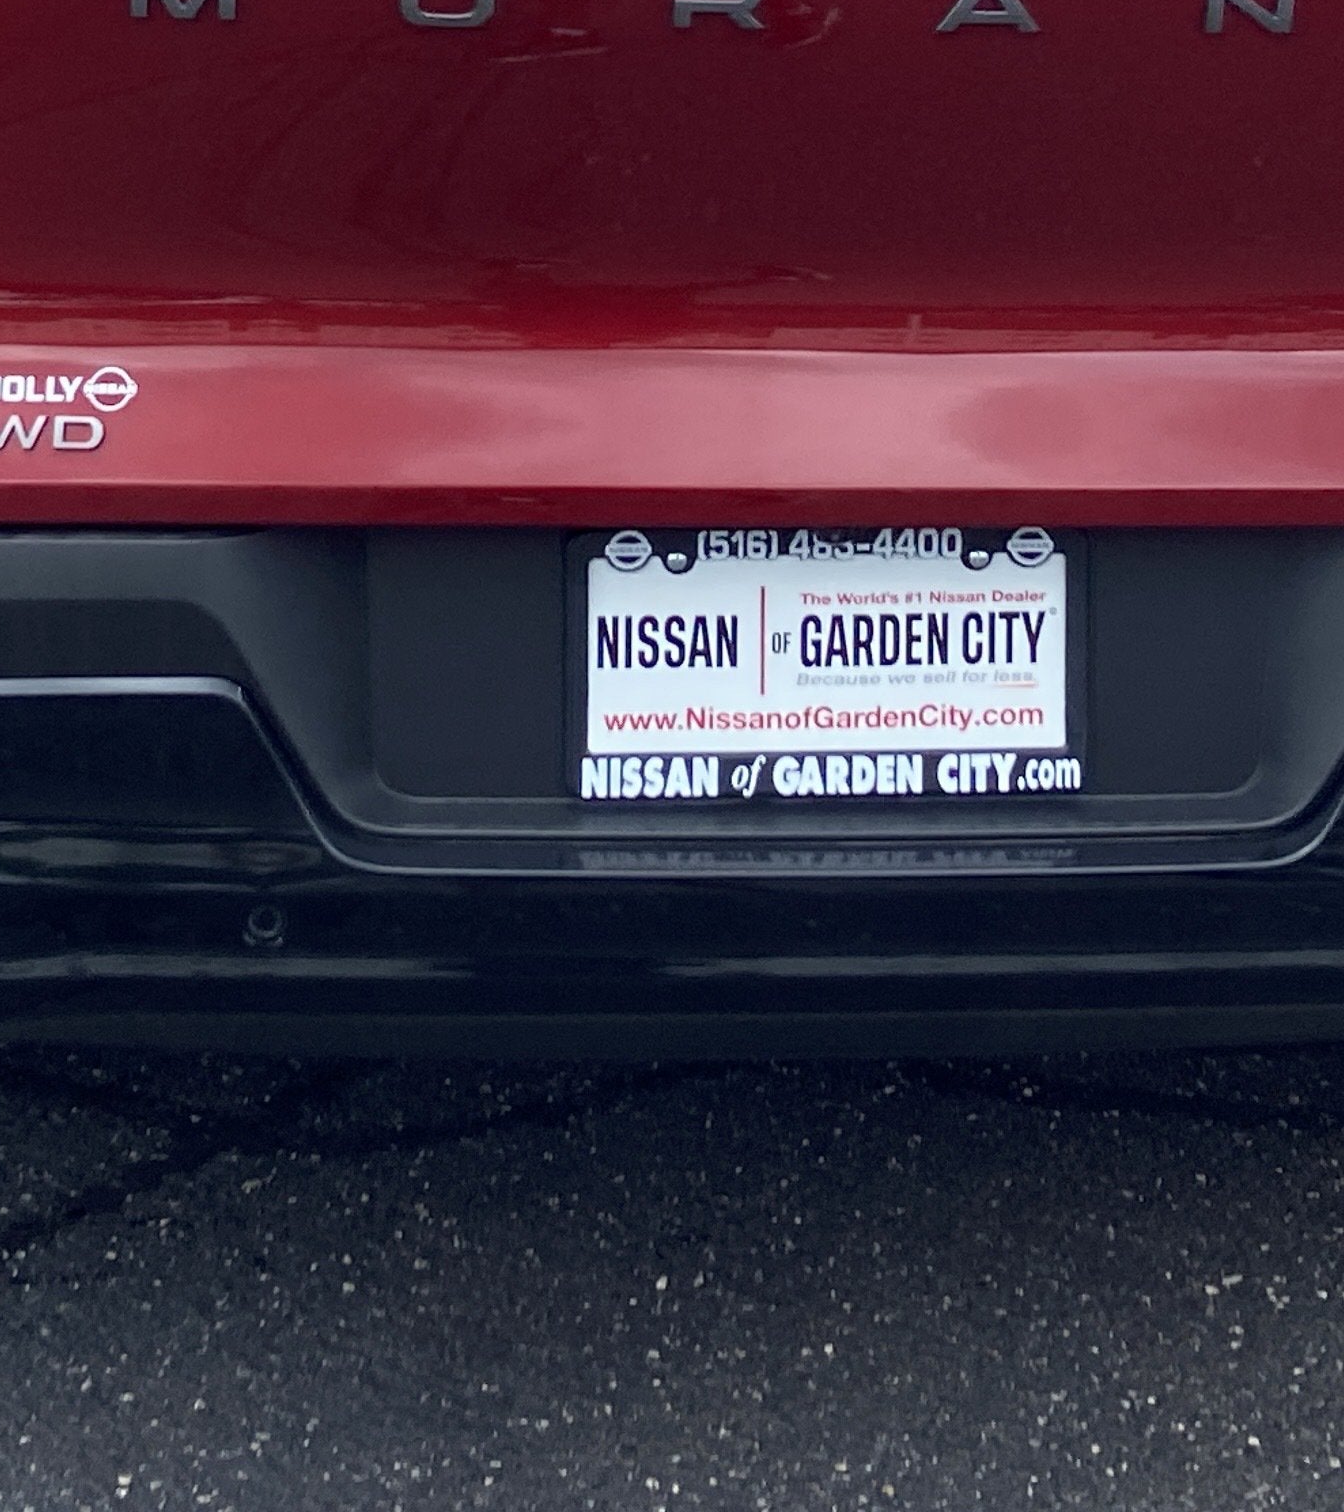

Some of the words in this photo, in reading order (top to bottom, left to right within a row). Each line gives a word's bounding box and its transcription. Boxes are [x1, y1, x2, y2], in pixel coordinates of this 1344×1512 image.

[697, 529, 779, 561] (516)
[801, 592, 832, 605] The
[837, 591, 899, 605] World's
[905, 591, 922, 604] #1
[929, 591, 986, 604] Nissan
[992, 589, 1046, 602] Dealer
[597, 615, 739, 669] NISSAN
[772, 632, 792, 655] OF
[800, 612, 949, 668] GARDEN
[962, 610, 1046, 665] CITY
[796, 672, 881, 686] Because
[888, 674, 916, 685] we
[923, 670, 957, 684] sell
[962, 670, 988, 683] for
[604, 703, 1045, 731] www.NissanofGardenCity.com
[581, 756, 719, 799] NISSAN
[730, 754, 767, 799] of
[772, 753, 924, 798] GARDEN
[936, 752, 1082, 794] CITY.com
